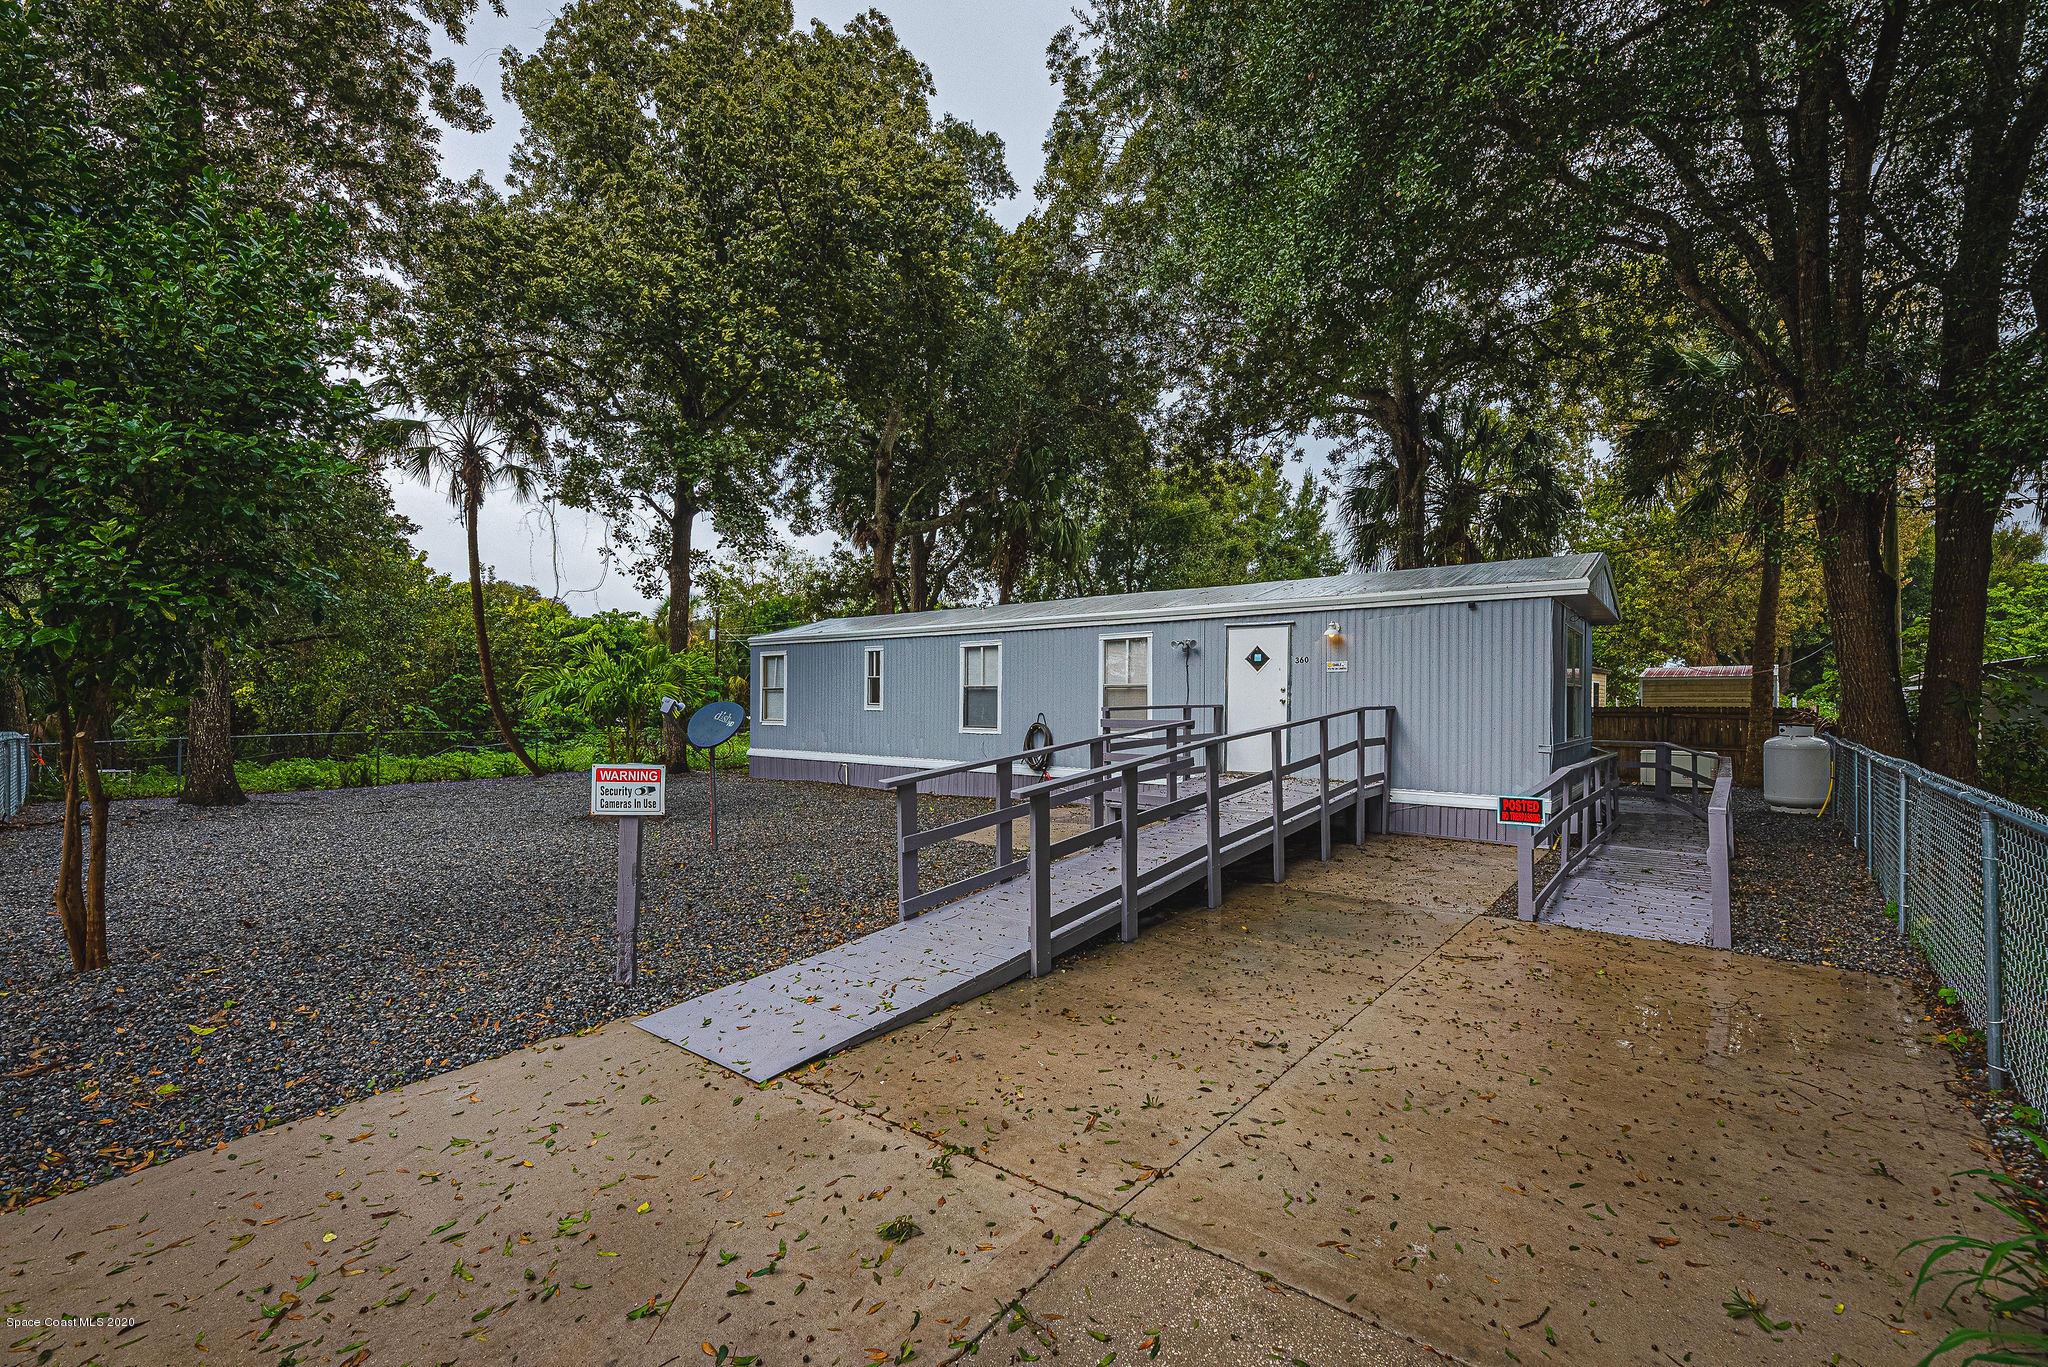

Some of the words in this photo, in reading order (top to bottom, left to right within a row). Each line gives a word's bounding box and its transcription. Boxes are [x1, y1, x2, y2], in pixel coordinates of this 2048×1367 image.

[1294, 656, 1310, 664] 360
[714, 711, 732, 722] dish
[600, 770, 658, 781] WARNING
[600, 785, 633, 798] Security
[600, 798, 632, 809] Cameras
[634, 798, 641, 809] In
[643, 798, 657, 809] Use
[1502, 798, 1540, 812] POSTED
[1501, 811, 1509, 821] NO
[1510, 812, 1541, 823] TRESPASSING
